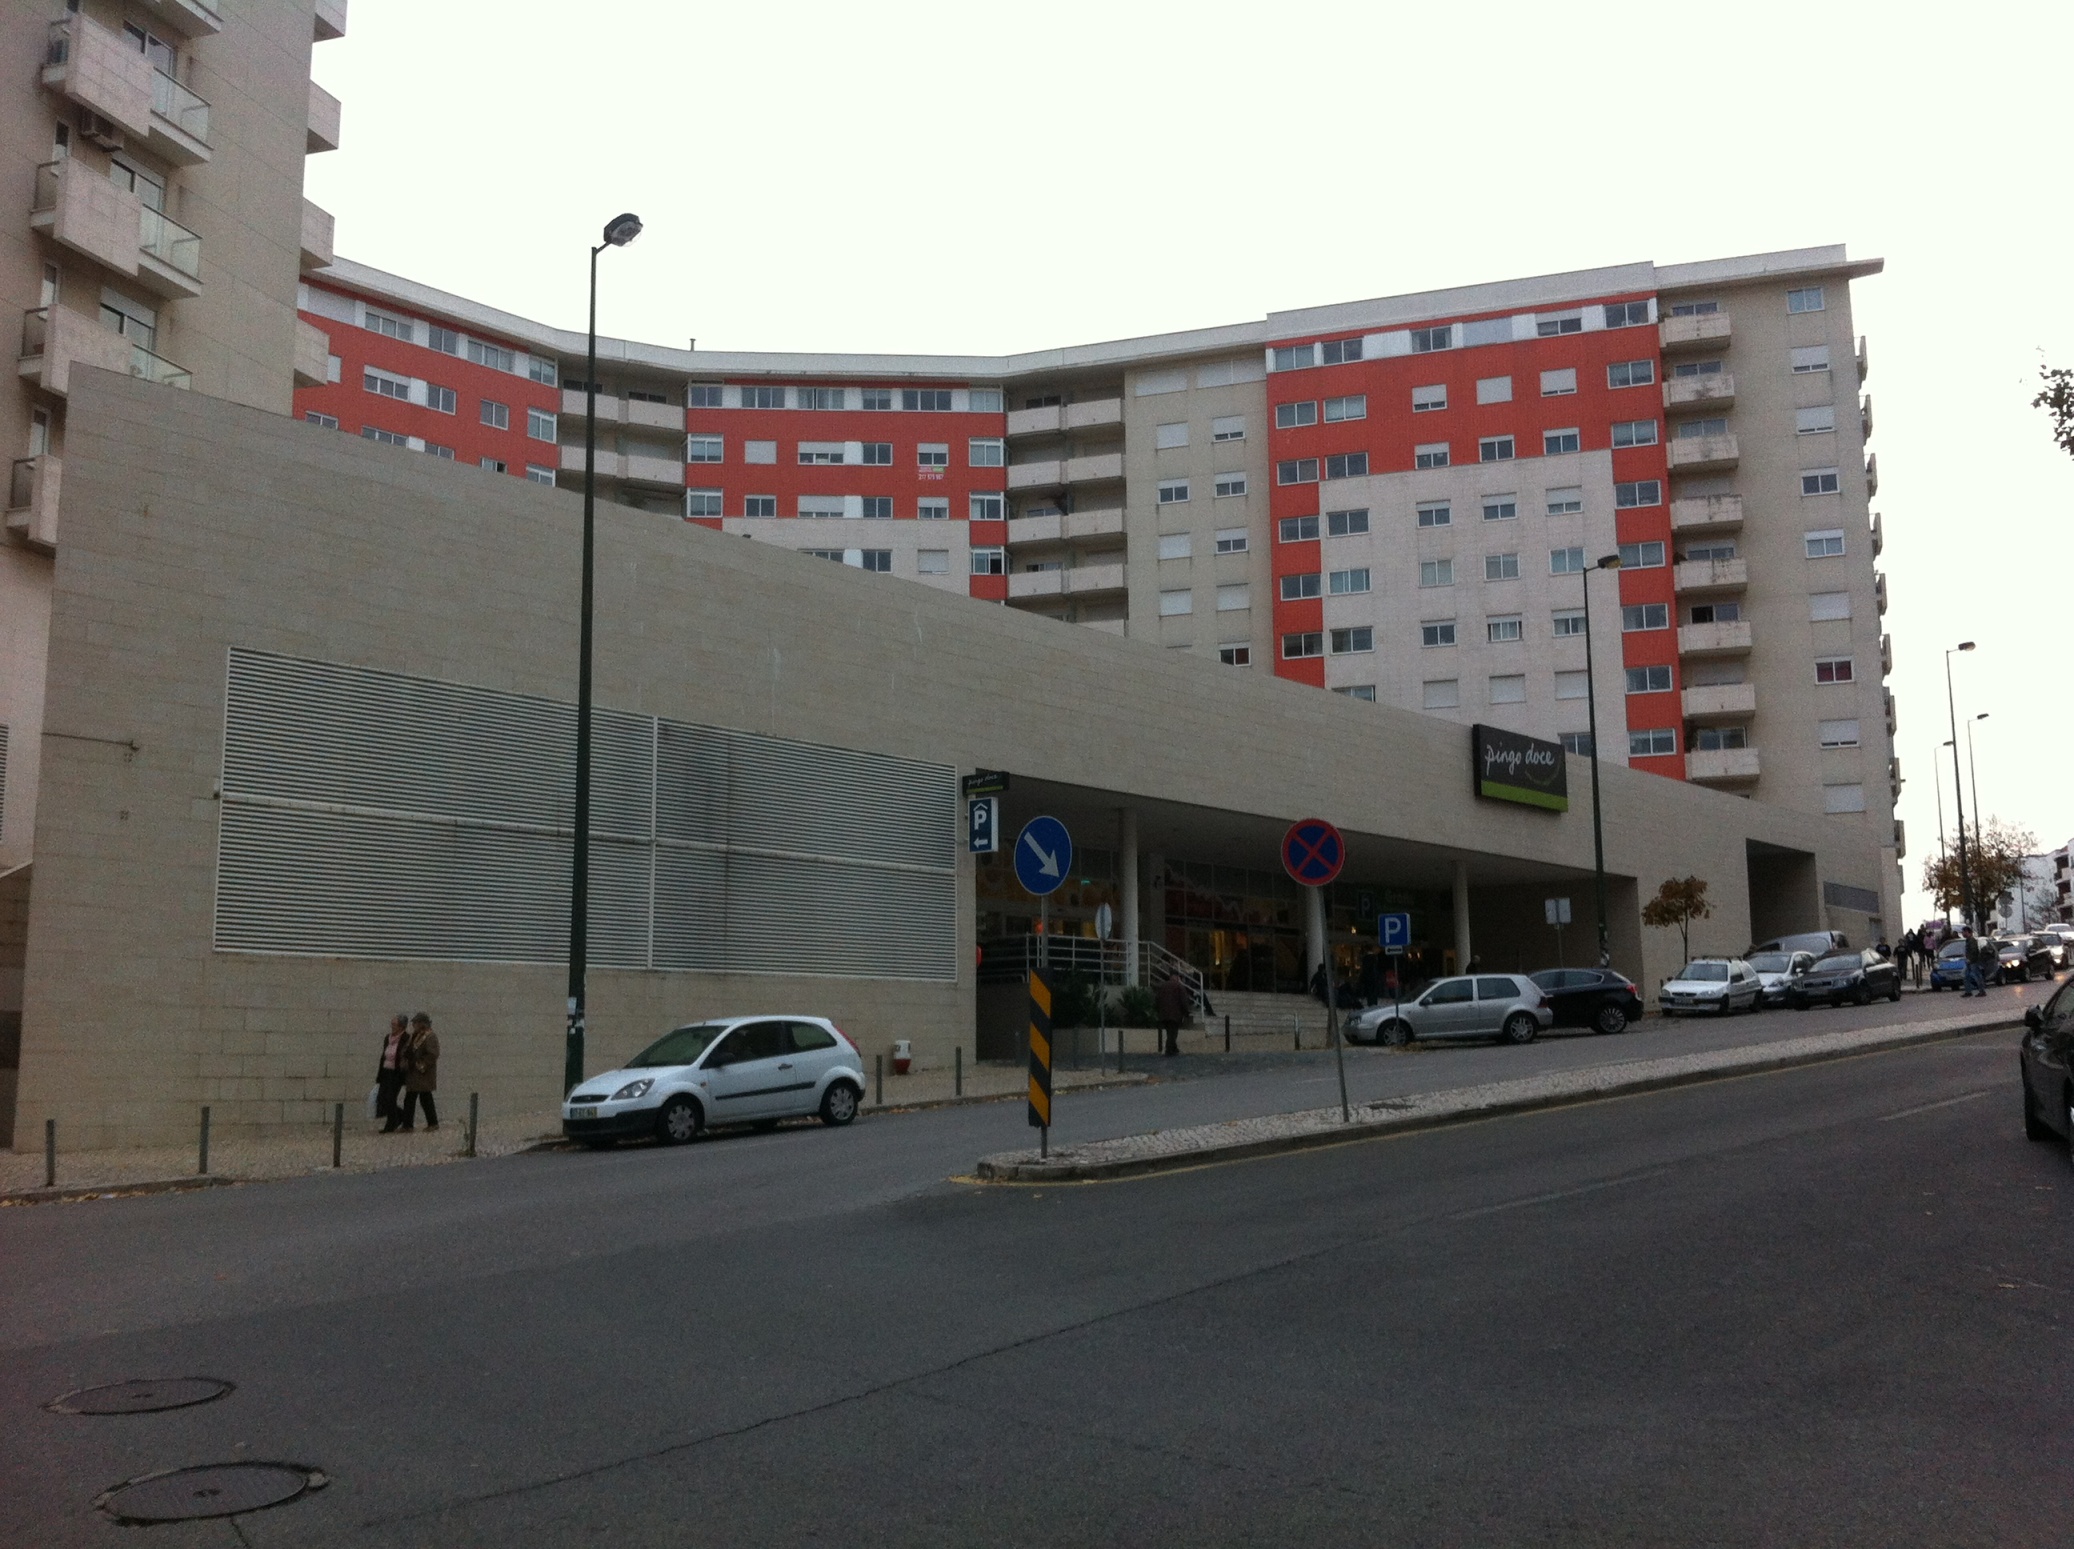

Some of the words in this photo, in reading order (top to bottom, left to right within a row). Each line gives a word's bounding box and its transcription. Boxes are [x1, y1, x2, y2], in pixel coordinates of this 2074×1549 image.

[1485, 742, 1522, 776] pingo
[1525, 742, 1555, 766] doce
[974, 810, 987, 830] P
[1385, 917, 1401, 943] P
